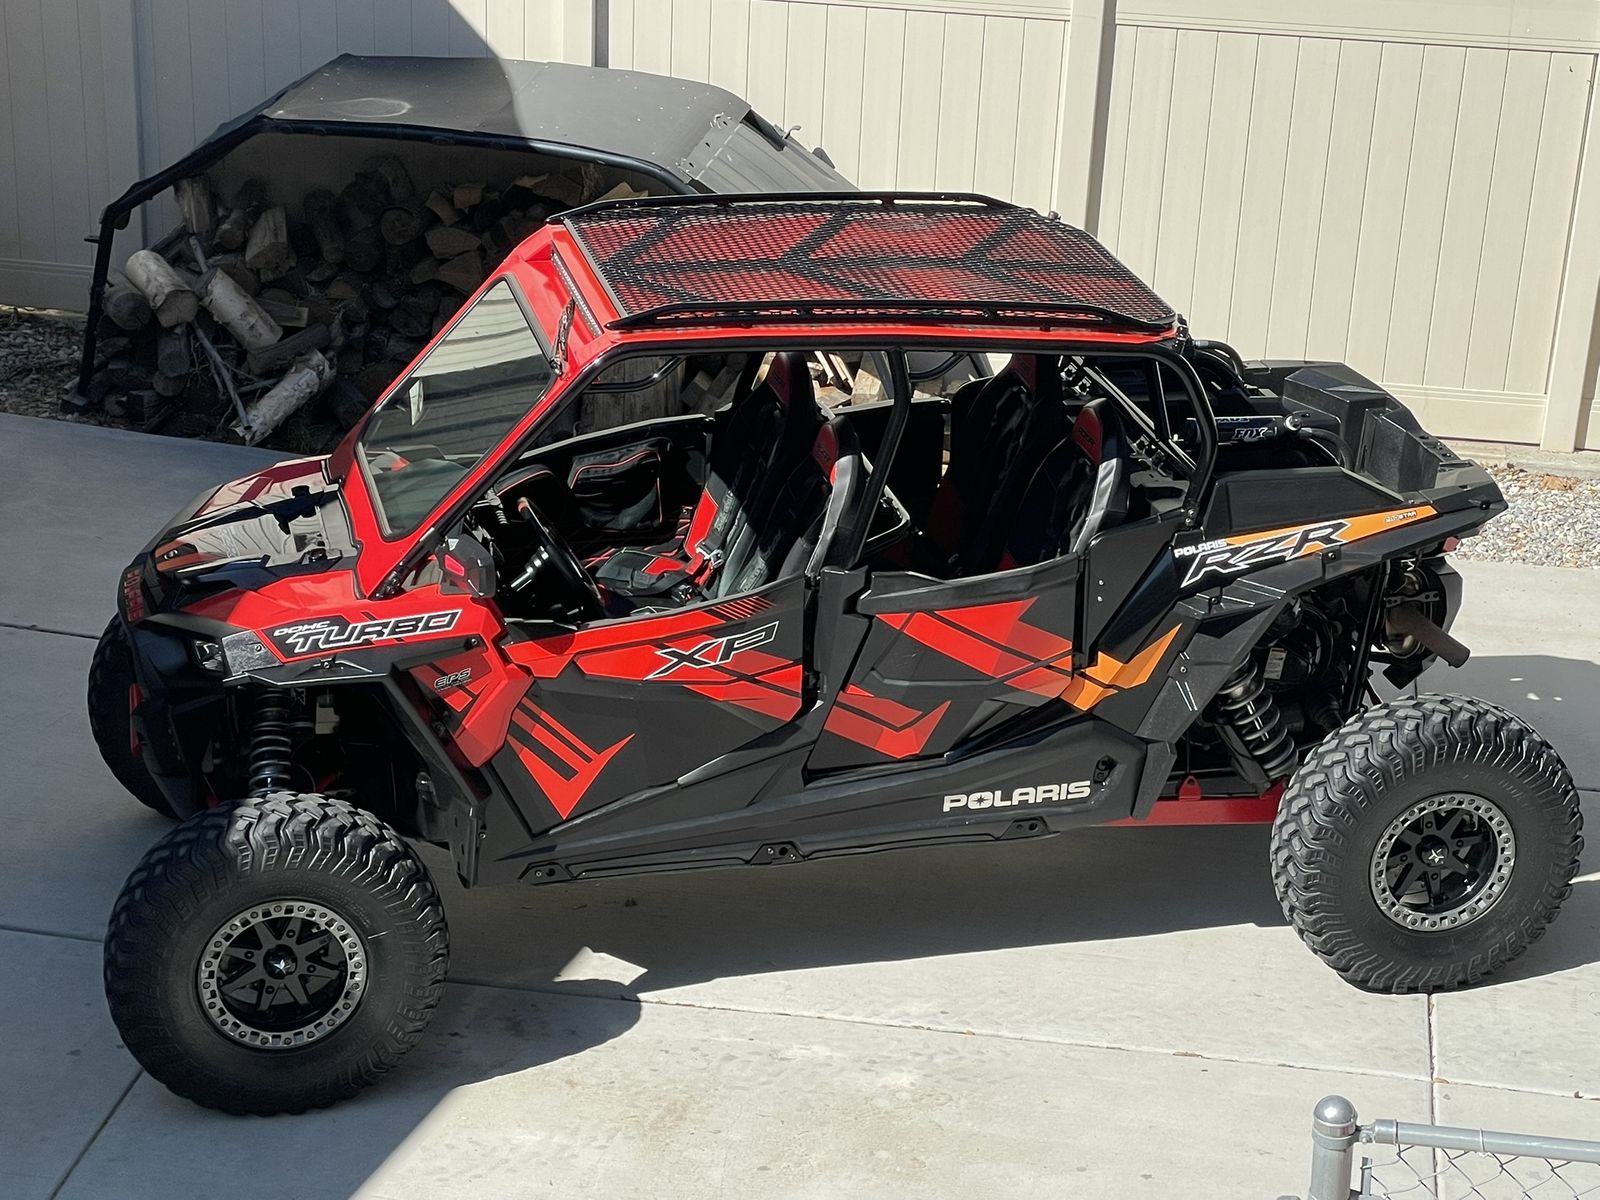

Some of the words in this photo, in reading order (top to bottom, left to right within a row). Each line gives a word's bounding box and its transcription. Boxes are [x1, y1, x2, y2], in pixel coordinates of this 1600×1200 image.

[1231, 426, 1269, 442] FOX
[1174, 538, 1228, 558] POLARIS
[1180, 519, 1351, 588] RZR
[273, 620, 331, 637] DOHC
[286, 608, 463, 654] TURBO
[643, 620, 780, 681] XP
[434, 667, 472, 690] EPS
[942, 780, 1091, 812] POLARIS
